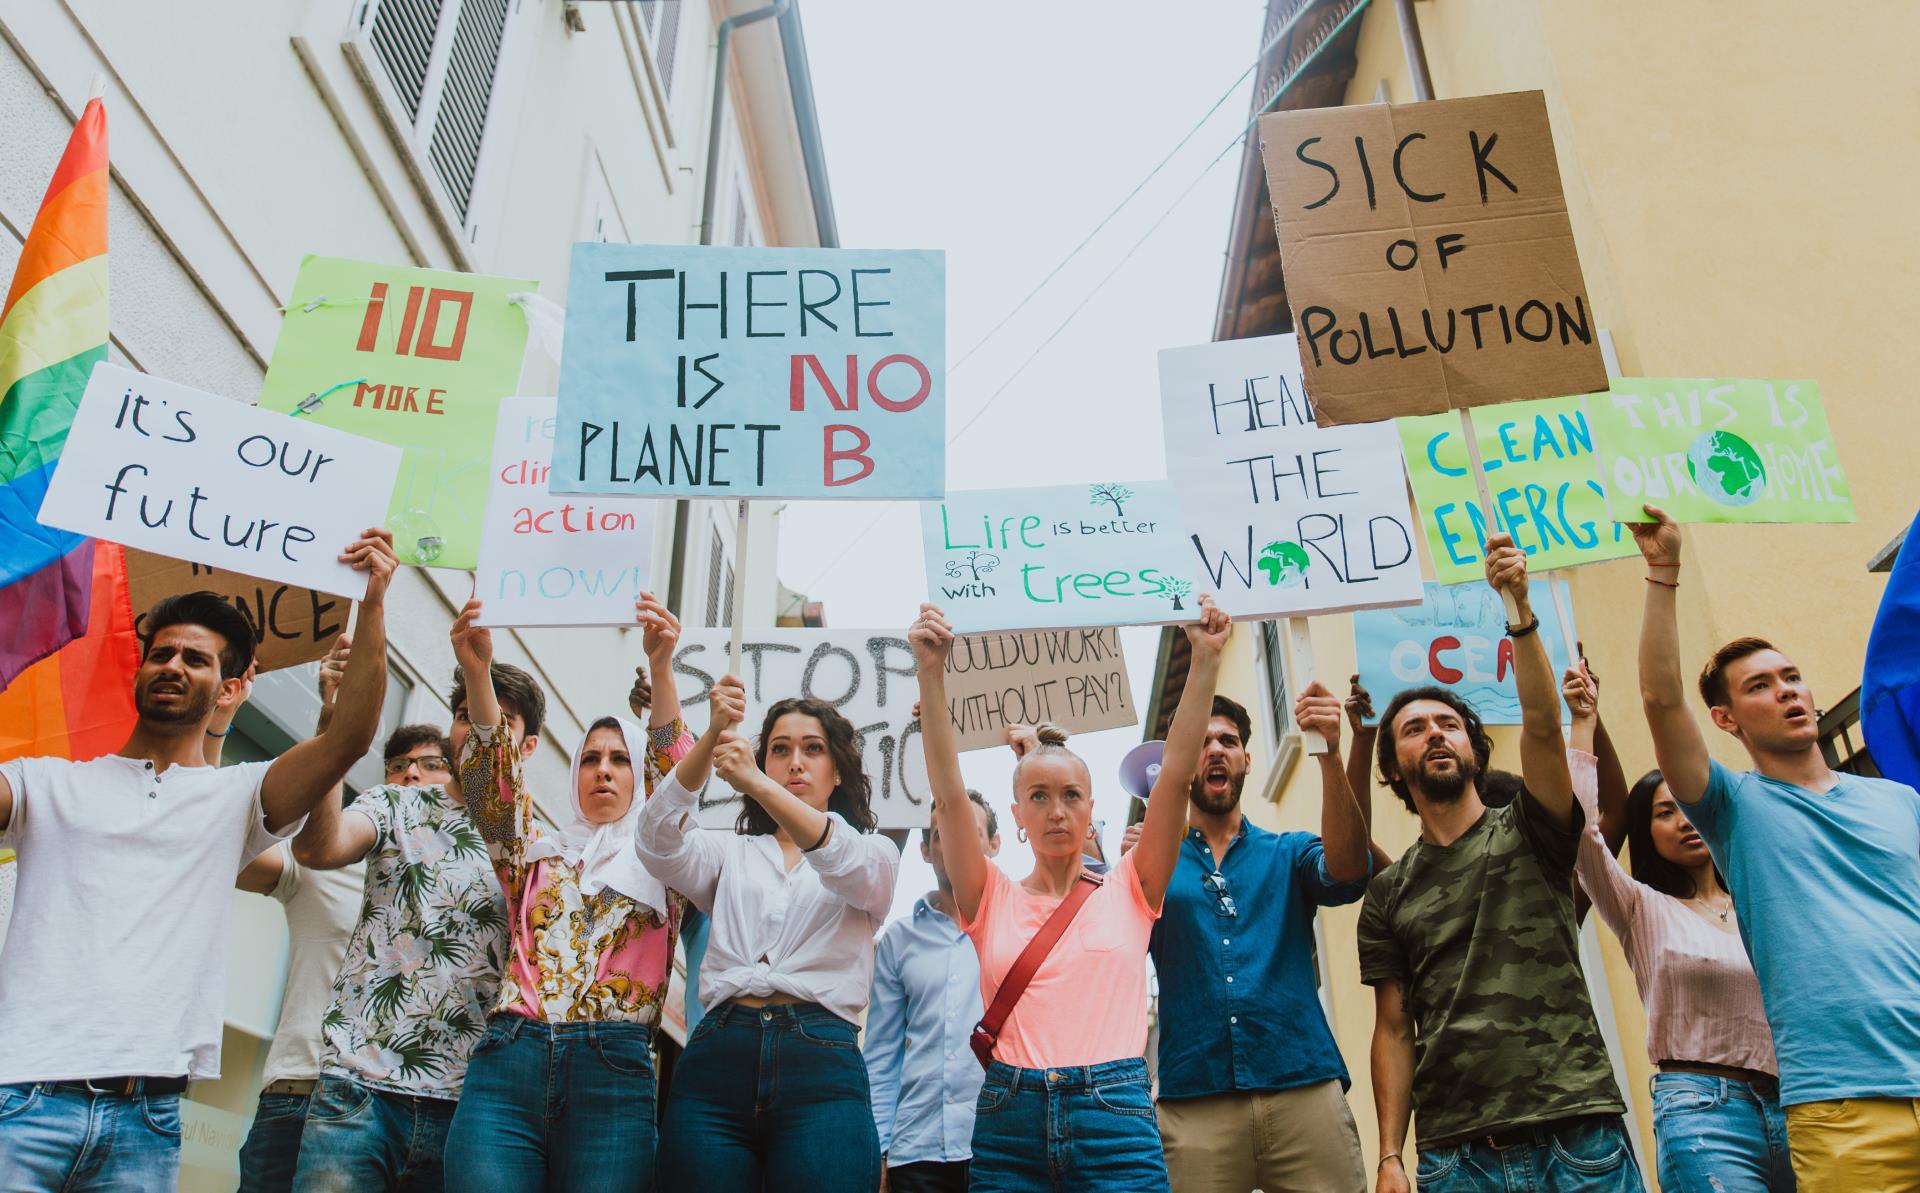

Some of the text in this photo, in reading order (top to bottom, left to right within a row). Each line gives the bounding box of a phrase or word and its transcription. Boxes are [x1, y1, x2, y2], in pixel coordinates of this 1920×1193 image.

[1296, 130, 1518, 211] SICK
[1386, 233, 1467, 272] OF
[356, 282, 474, 361] NO
[605, 268, 894, 342] THERE
[1300, 296, 1593, 367] POLLUTION
[353, 382, 448, 415] MORE
[677, 353, 932, 413] IS NO
[1610, 383, 1809, 429] THIS IS
[115, 388, 335, 483] it's our
[579, 421, 876, 487] PLANET B
[1226, 448, 1360, 504] THE
[1613, 437, 1849, 504] OUR HOME
[105, 464, 315, 562] future
[513, 504, 636, 534] action
[941, 503, 1158, 550] Life is better
[499, 565, 642, 601] now!
[941, 563, 1168, 604] with trees
[672, 636, 918, 708] STOP
[948, 671, 1125, 735] WITHOUT PAY?
